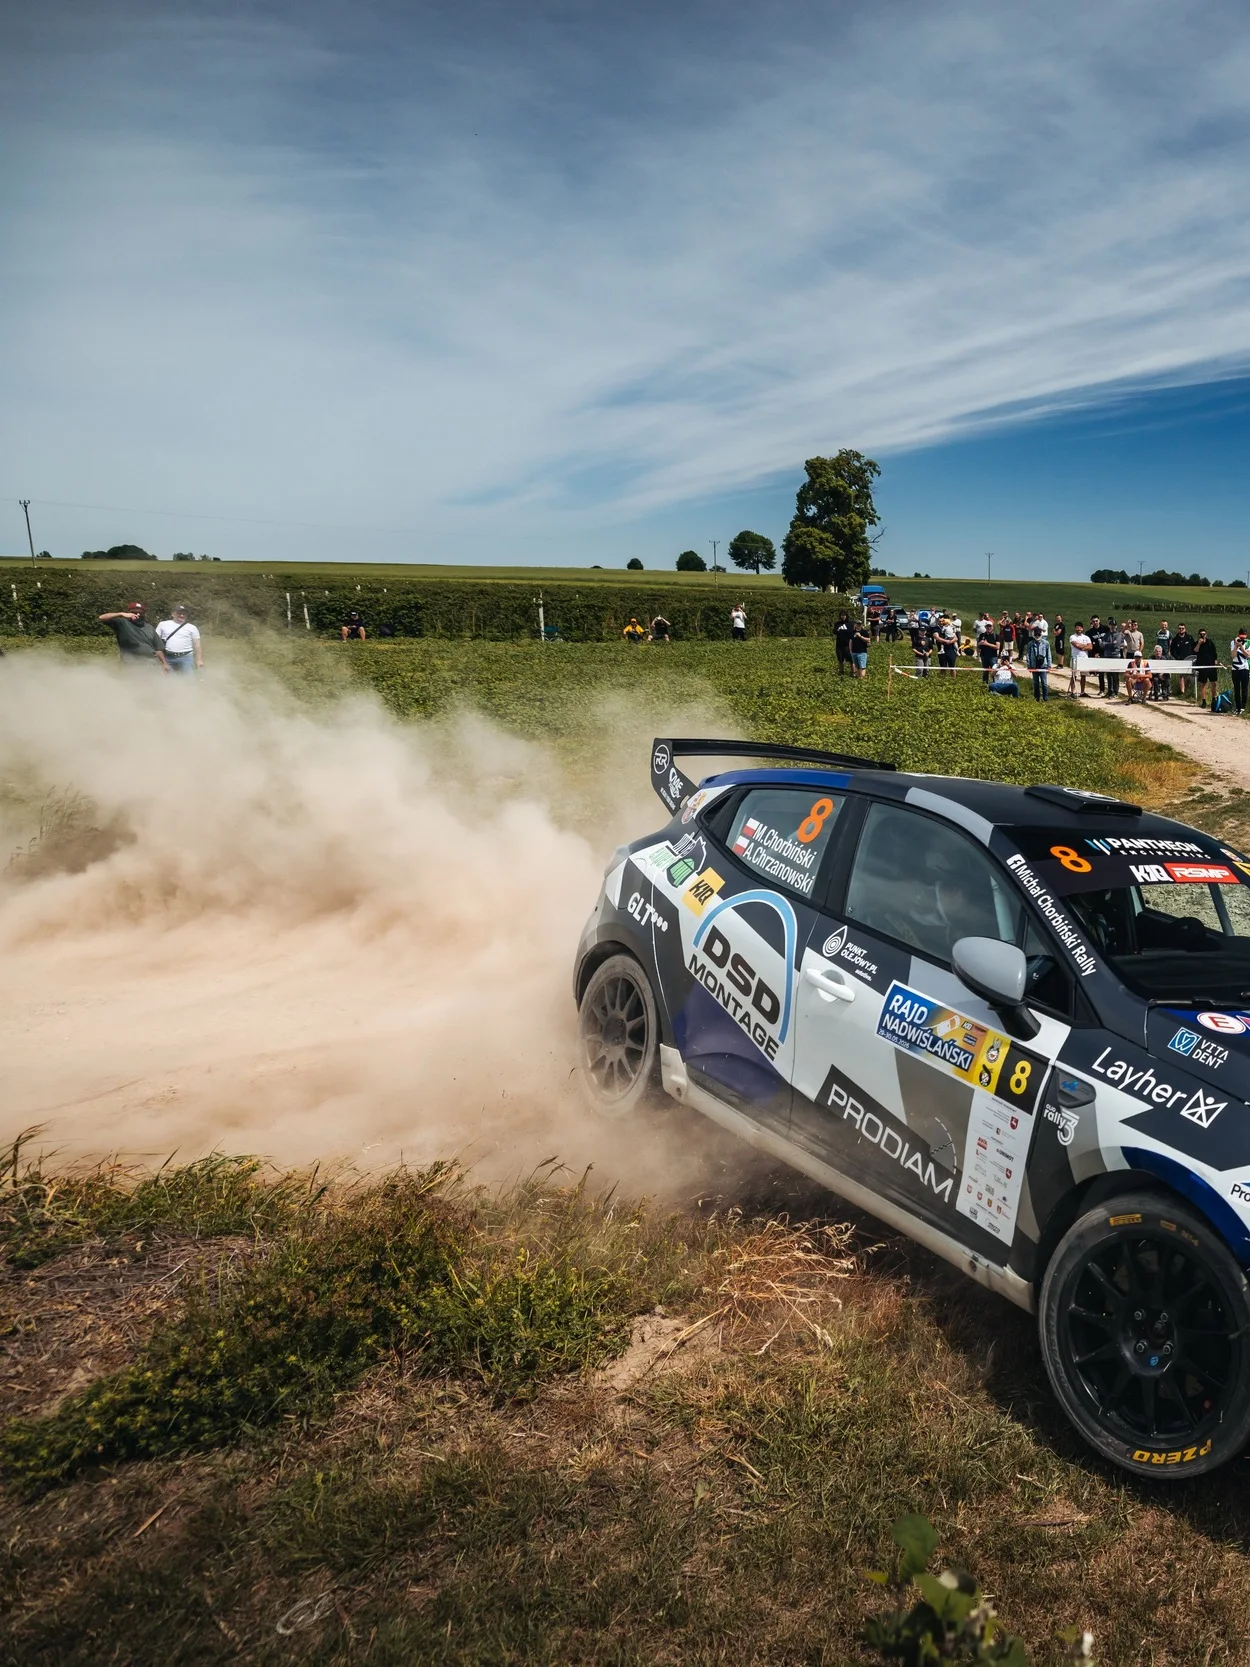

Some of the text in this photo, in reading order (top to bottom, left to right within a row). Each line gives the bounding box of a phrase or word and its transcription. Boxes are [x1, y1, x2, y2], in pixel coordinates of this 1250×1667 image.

[797, 797, 833, 843] 8
[742, 842, 815, 893] A.Chrzanowski
[752, 823, 817, 868] M.Chorbiński
[1050, 846, 1092, 873] 8
[1105, 838, 1203, 853] PANTHEON
[1171, 867, 1230, 878] RSMP
[1014, 864, 1046, 897] Michał
[1037, 895, 1081, 949] Chorbiński
[1071, 945, 1097, 977] Rally
[845, 942, 868, 957] PUNKT
[702, 925, 780, 1025] DSD
[688, 953, 779, 1061] MONTAGE
[889, 994, 928, 1025] RAJD
[882, 1013, 972, 1070] NADWIŚLAŃSKI
[1192, 1049, 1224, 1069] DENT
[1010, 1060, 1032, 1095] 8
[1091, 1046, 1188, 1109] Layher
[1043, 1108, 1067, 1129] rally
[827, 1083, 954, 1203] PRODIAM
